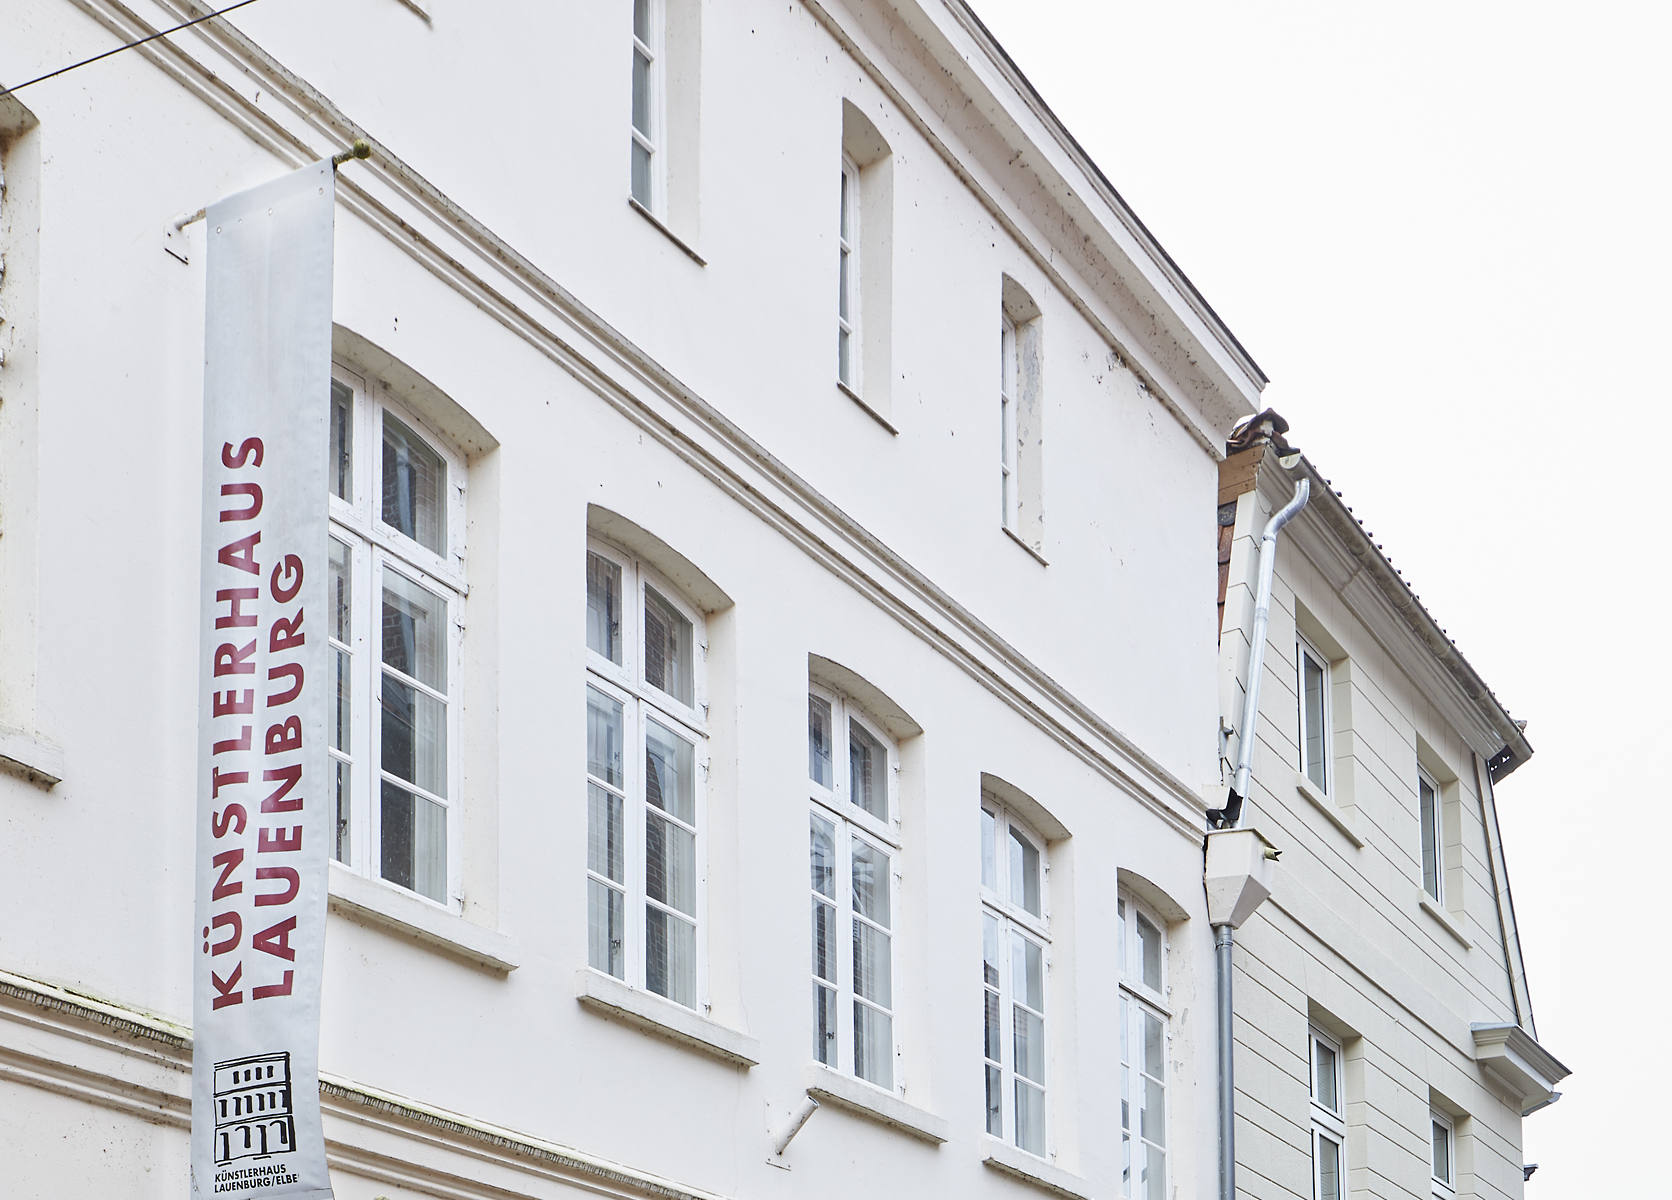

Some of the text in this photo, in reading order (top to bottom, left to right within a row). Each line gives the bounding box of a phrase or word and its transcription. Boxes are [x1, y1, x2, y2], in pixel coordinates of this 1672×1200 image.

[203, 436, 265, 1010] KÜNSTLERHAUS
[252, 553, 305, 1001] LAUENBURG
[214, 1173, 298, 1193] LAUENBURG/ELBE
[215, 1164, 286, 1183] KÜNSTLERHAUS
